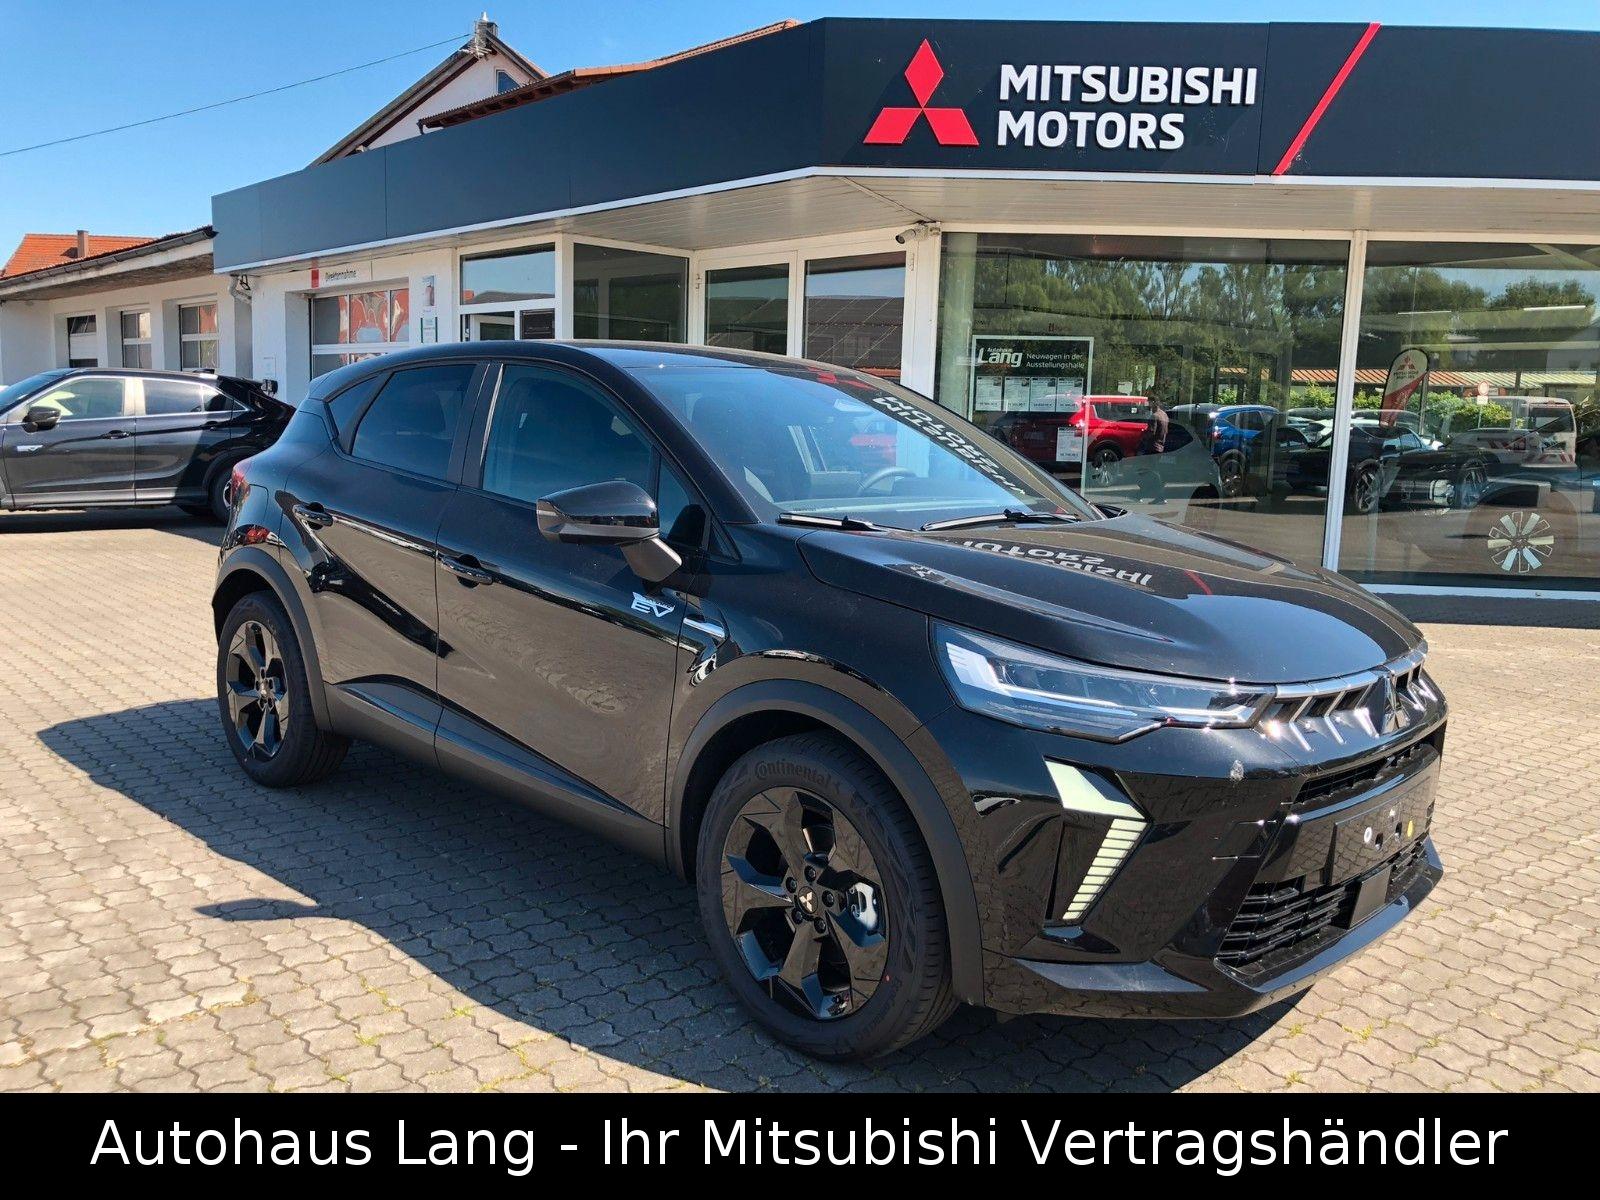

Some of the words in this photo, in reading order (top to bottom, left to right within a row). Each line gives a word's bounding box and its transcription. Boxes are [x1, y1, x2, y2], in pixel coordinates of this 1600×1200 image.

[999, 63, 1258, 106] MITSUBISHI
[996, 109, 1186, 151] MOTORS
[977, 347, 1023, 368] Lang
[1026, 353, 1062, 361] Neuwagen
[1026, 361, 1085, 369] Ausstellungshalle
[754, 760, 832, 785] Continental
